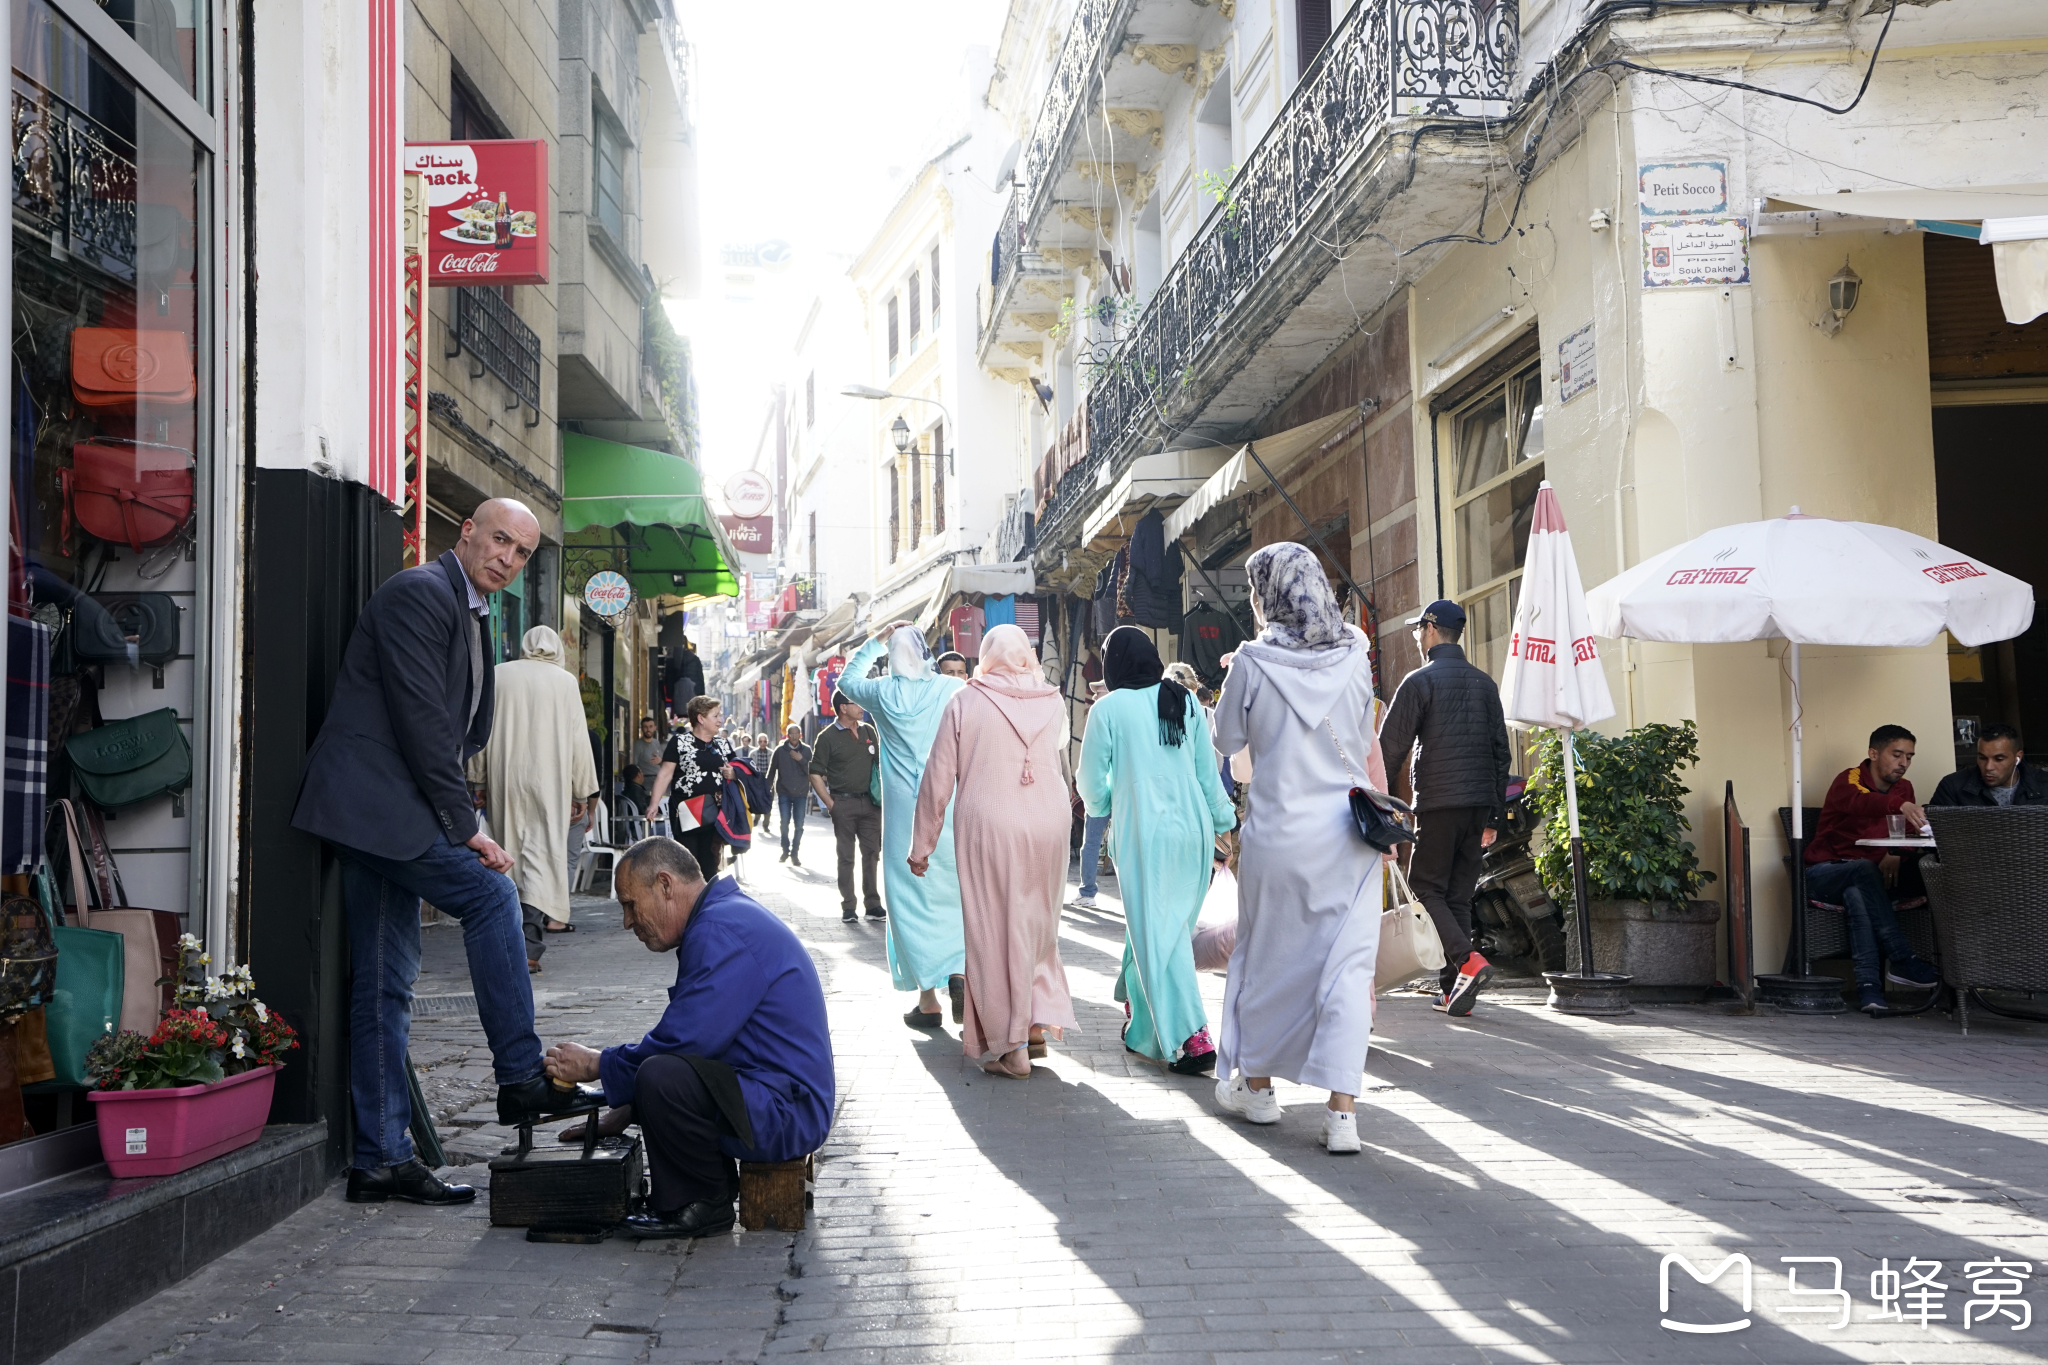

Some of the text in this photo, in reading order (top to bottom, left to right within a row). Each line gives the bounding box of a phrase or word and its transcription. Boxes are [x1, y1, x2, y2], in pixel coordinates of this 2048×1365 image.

[415, 154, 463, 168] سناك
[424, 170, 472, 186] nack
[1653, 182, 1715, 196] Petit Socco
[1677, 240, 1736, 251] السوق الداخل
[438, 252, 502, 274] Coca-Cola
[1678, 265, 1736, 275] Souk Dakhel
[738, 522, 757, 533] جوار
[729, 529, 762, 542] Jiwar
[589, 586, 626, 600] Coca-Cola
[93, 731, 156, 758] LOEWE
